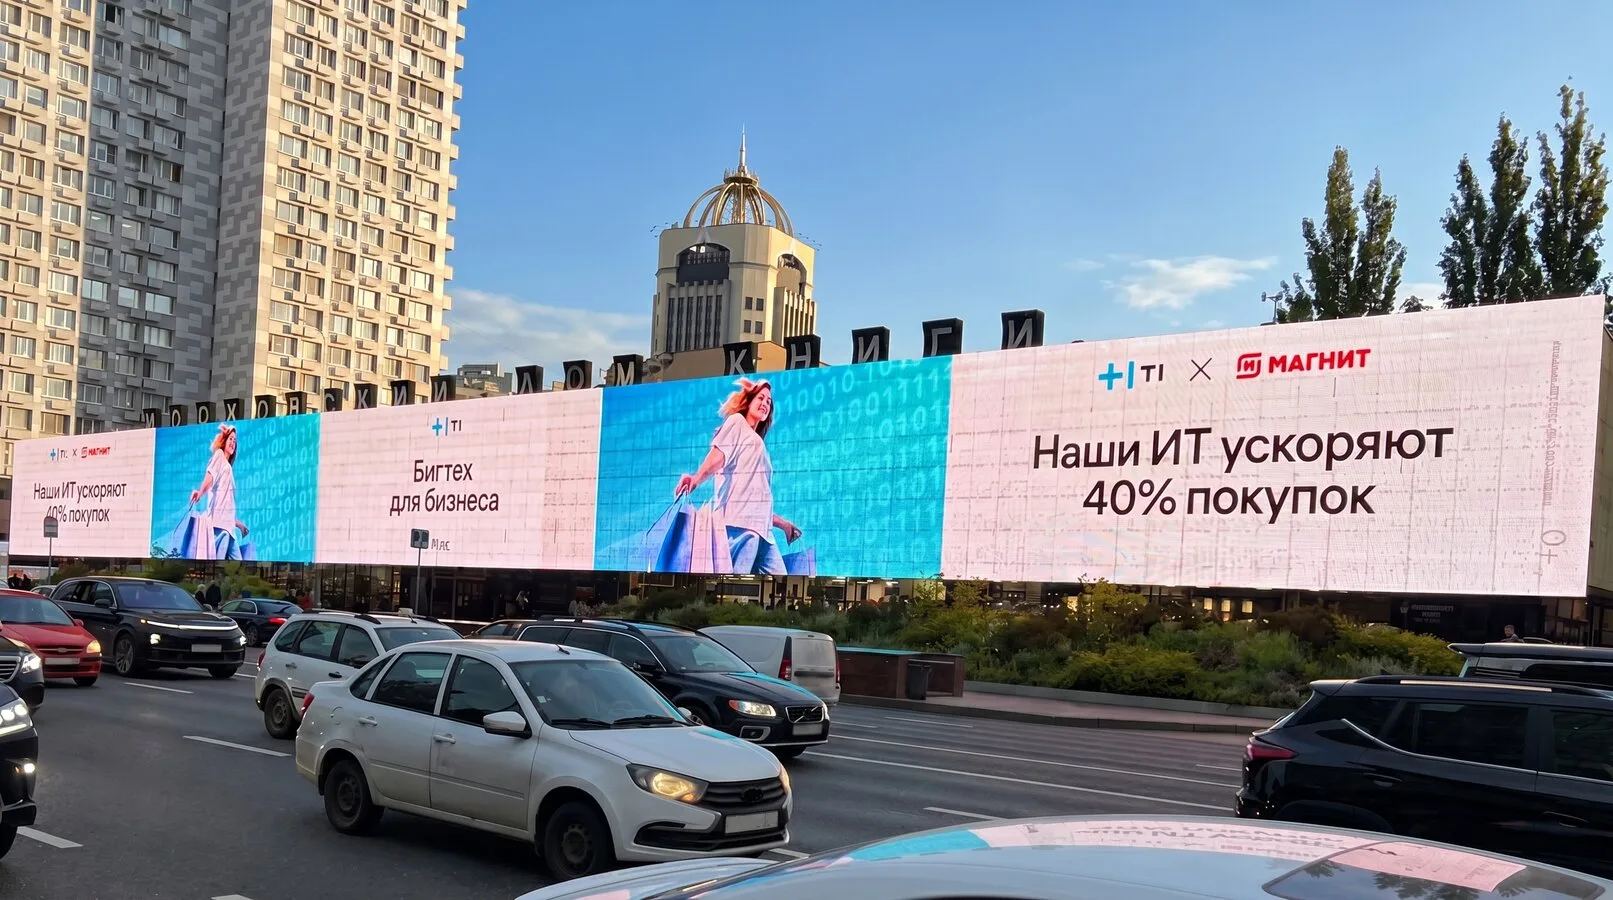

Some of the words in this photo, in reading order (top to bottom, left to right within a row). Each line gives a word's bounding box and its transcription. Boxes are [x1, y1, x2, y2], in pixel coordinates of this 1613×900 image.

[730, 317, 1034, 376] КНИГИ
[1268, 348, 1371, 374] МАГНИТ
[1033, 434, 1139, 469] Наши
[1152, 427, 1212, 466] ИТ
[1222, 427, 1454, 473] ускоряют
[413, 460, 473, 483] Бигтех
[33, 483, 60, 500] Наши
[62, 481, 76, 499] ИТ
[77, 483, 127, 503] ускоряют
[390, 494, 421, 516] для
[425, 487, 499, 512] бизнеса
[1083, 477, 1177, 515] 40%
[1187, 484, 1376, 524] покупок
[46, 504, 67, 522] 40%
[69, 508, 110, 527] покупок
